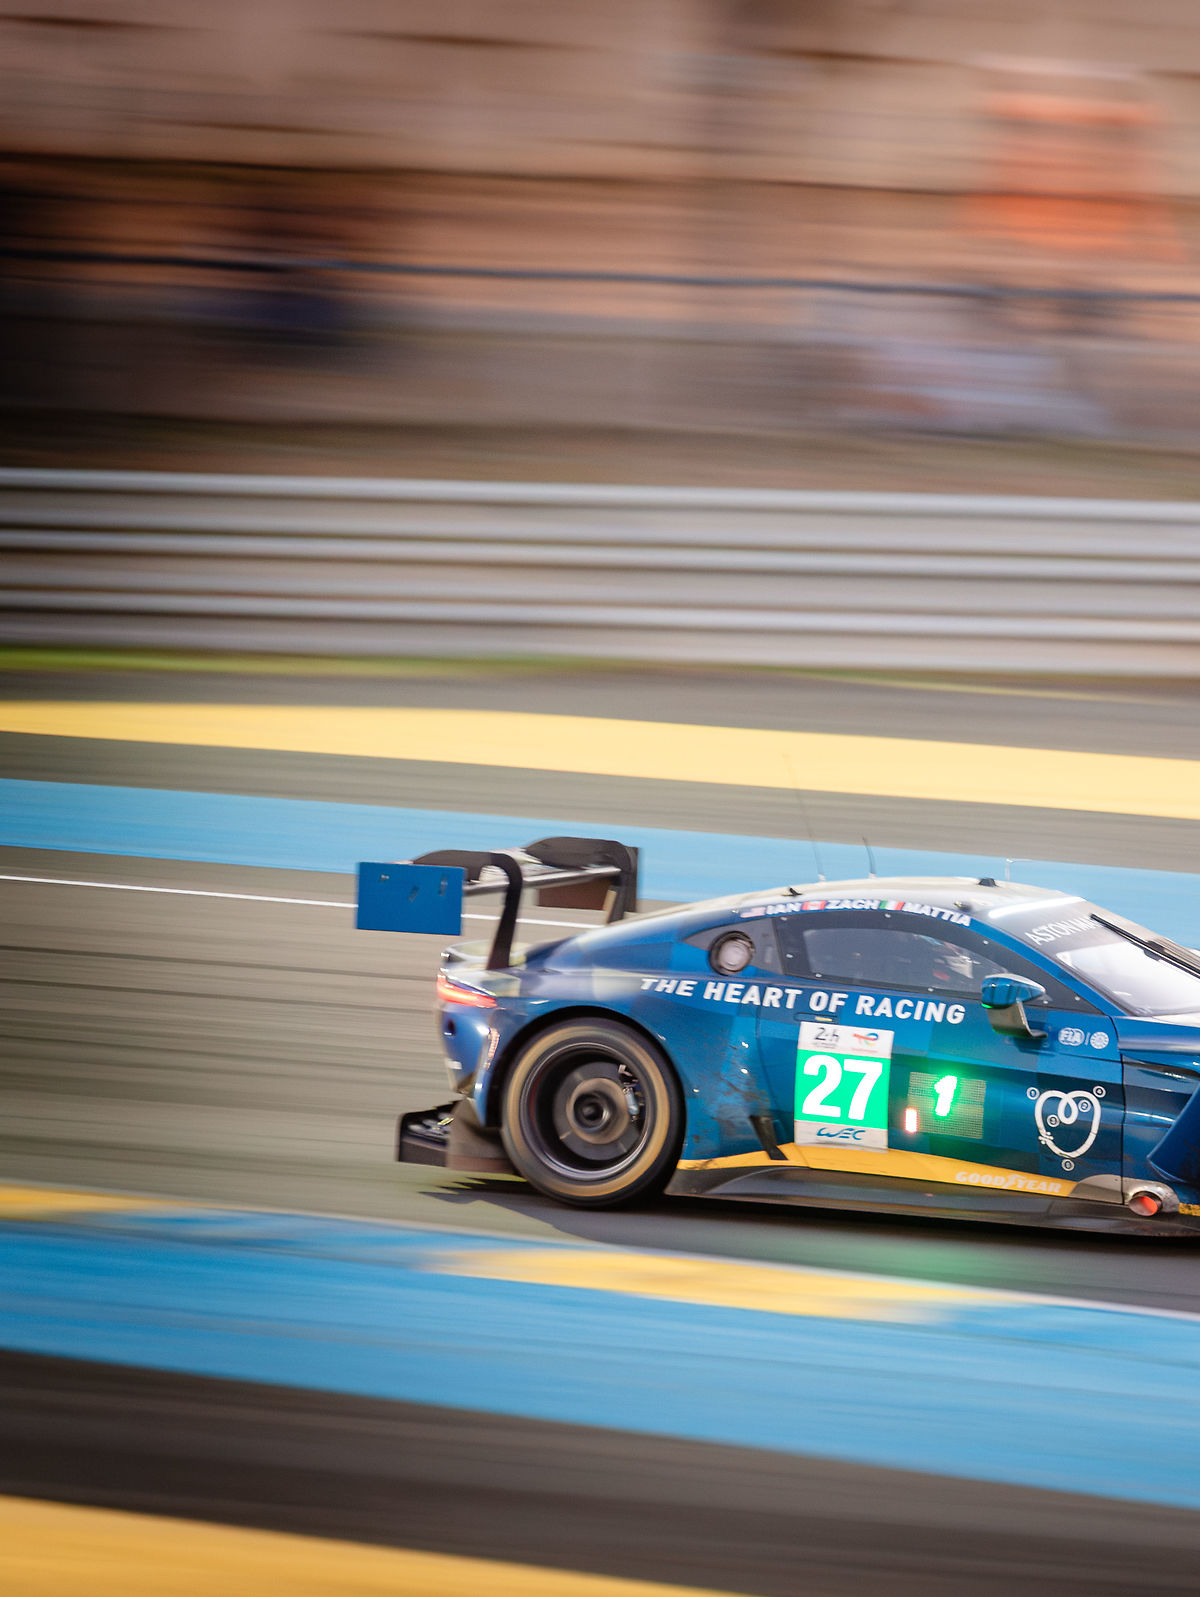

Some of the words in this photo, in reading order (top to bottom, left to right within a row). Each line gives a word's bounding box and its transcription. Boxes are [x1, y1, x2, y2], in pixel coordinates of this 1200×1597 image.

[766, 902, 801, 915] IAN
[825, 899, 878, 910] ZACH
[902, 902, 971, 927] MATTIA
[1024, 919, 1083, 946] ASTON
[640, 978, 698, 997] THE
[703, 981, 803, 1009] HEART
[808, 991, 849, 1013] OF
[855, 995, 966, 1025] RACING
[802, 1054, 883, 1121] 27
[934, 1075, 958, 1117] 1
[816, 1127, 866, 1140] WEC
[955, 1171, 1062, 1193] GOODYEAR
